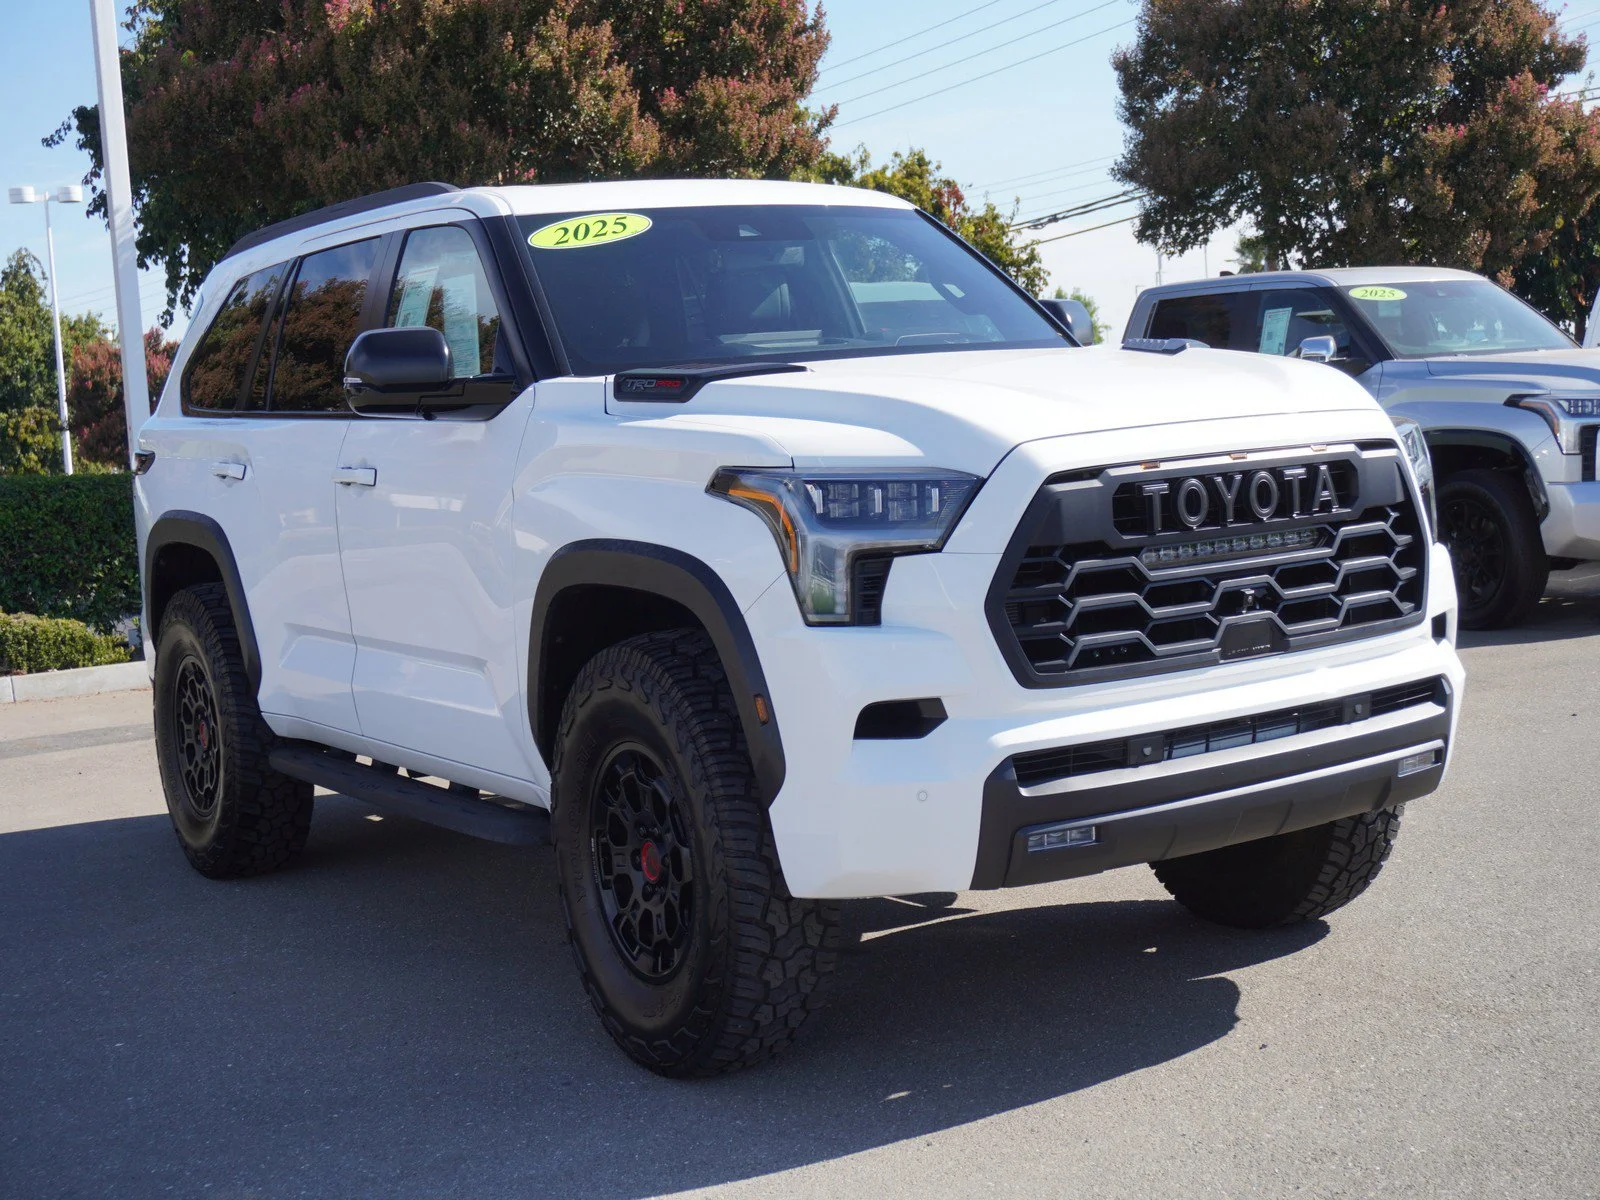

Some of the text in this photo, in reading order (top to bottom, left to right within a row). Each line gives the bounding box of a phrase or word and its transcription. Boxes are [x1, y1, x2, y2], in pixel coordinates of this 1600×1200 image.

[553, 216, 628, 246] 2025
[1360, 288, 1396, 299] 2025
[1141, 464, 1340, 532] TOYOTA
